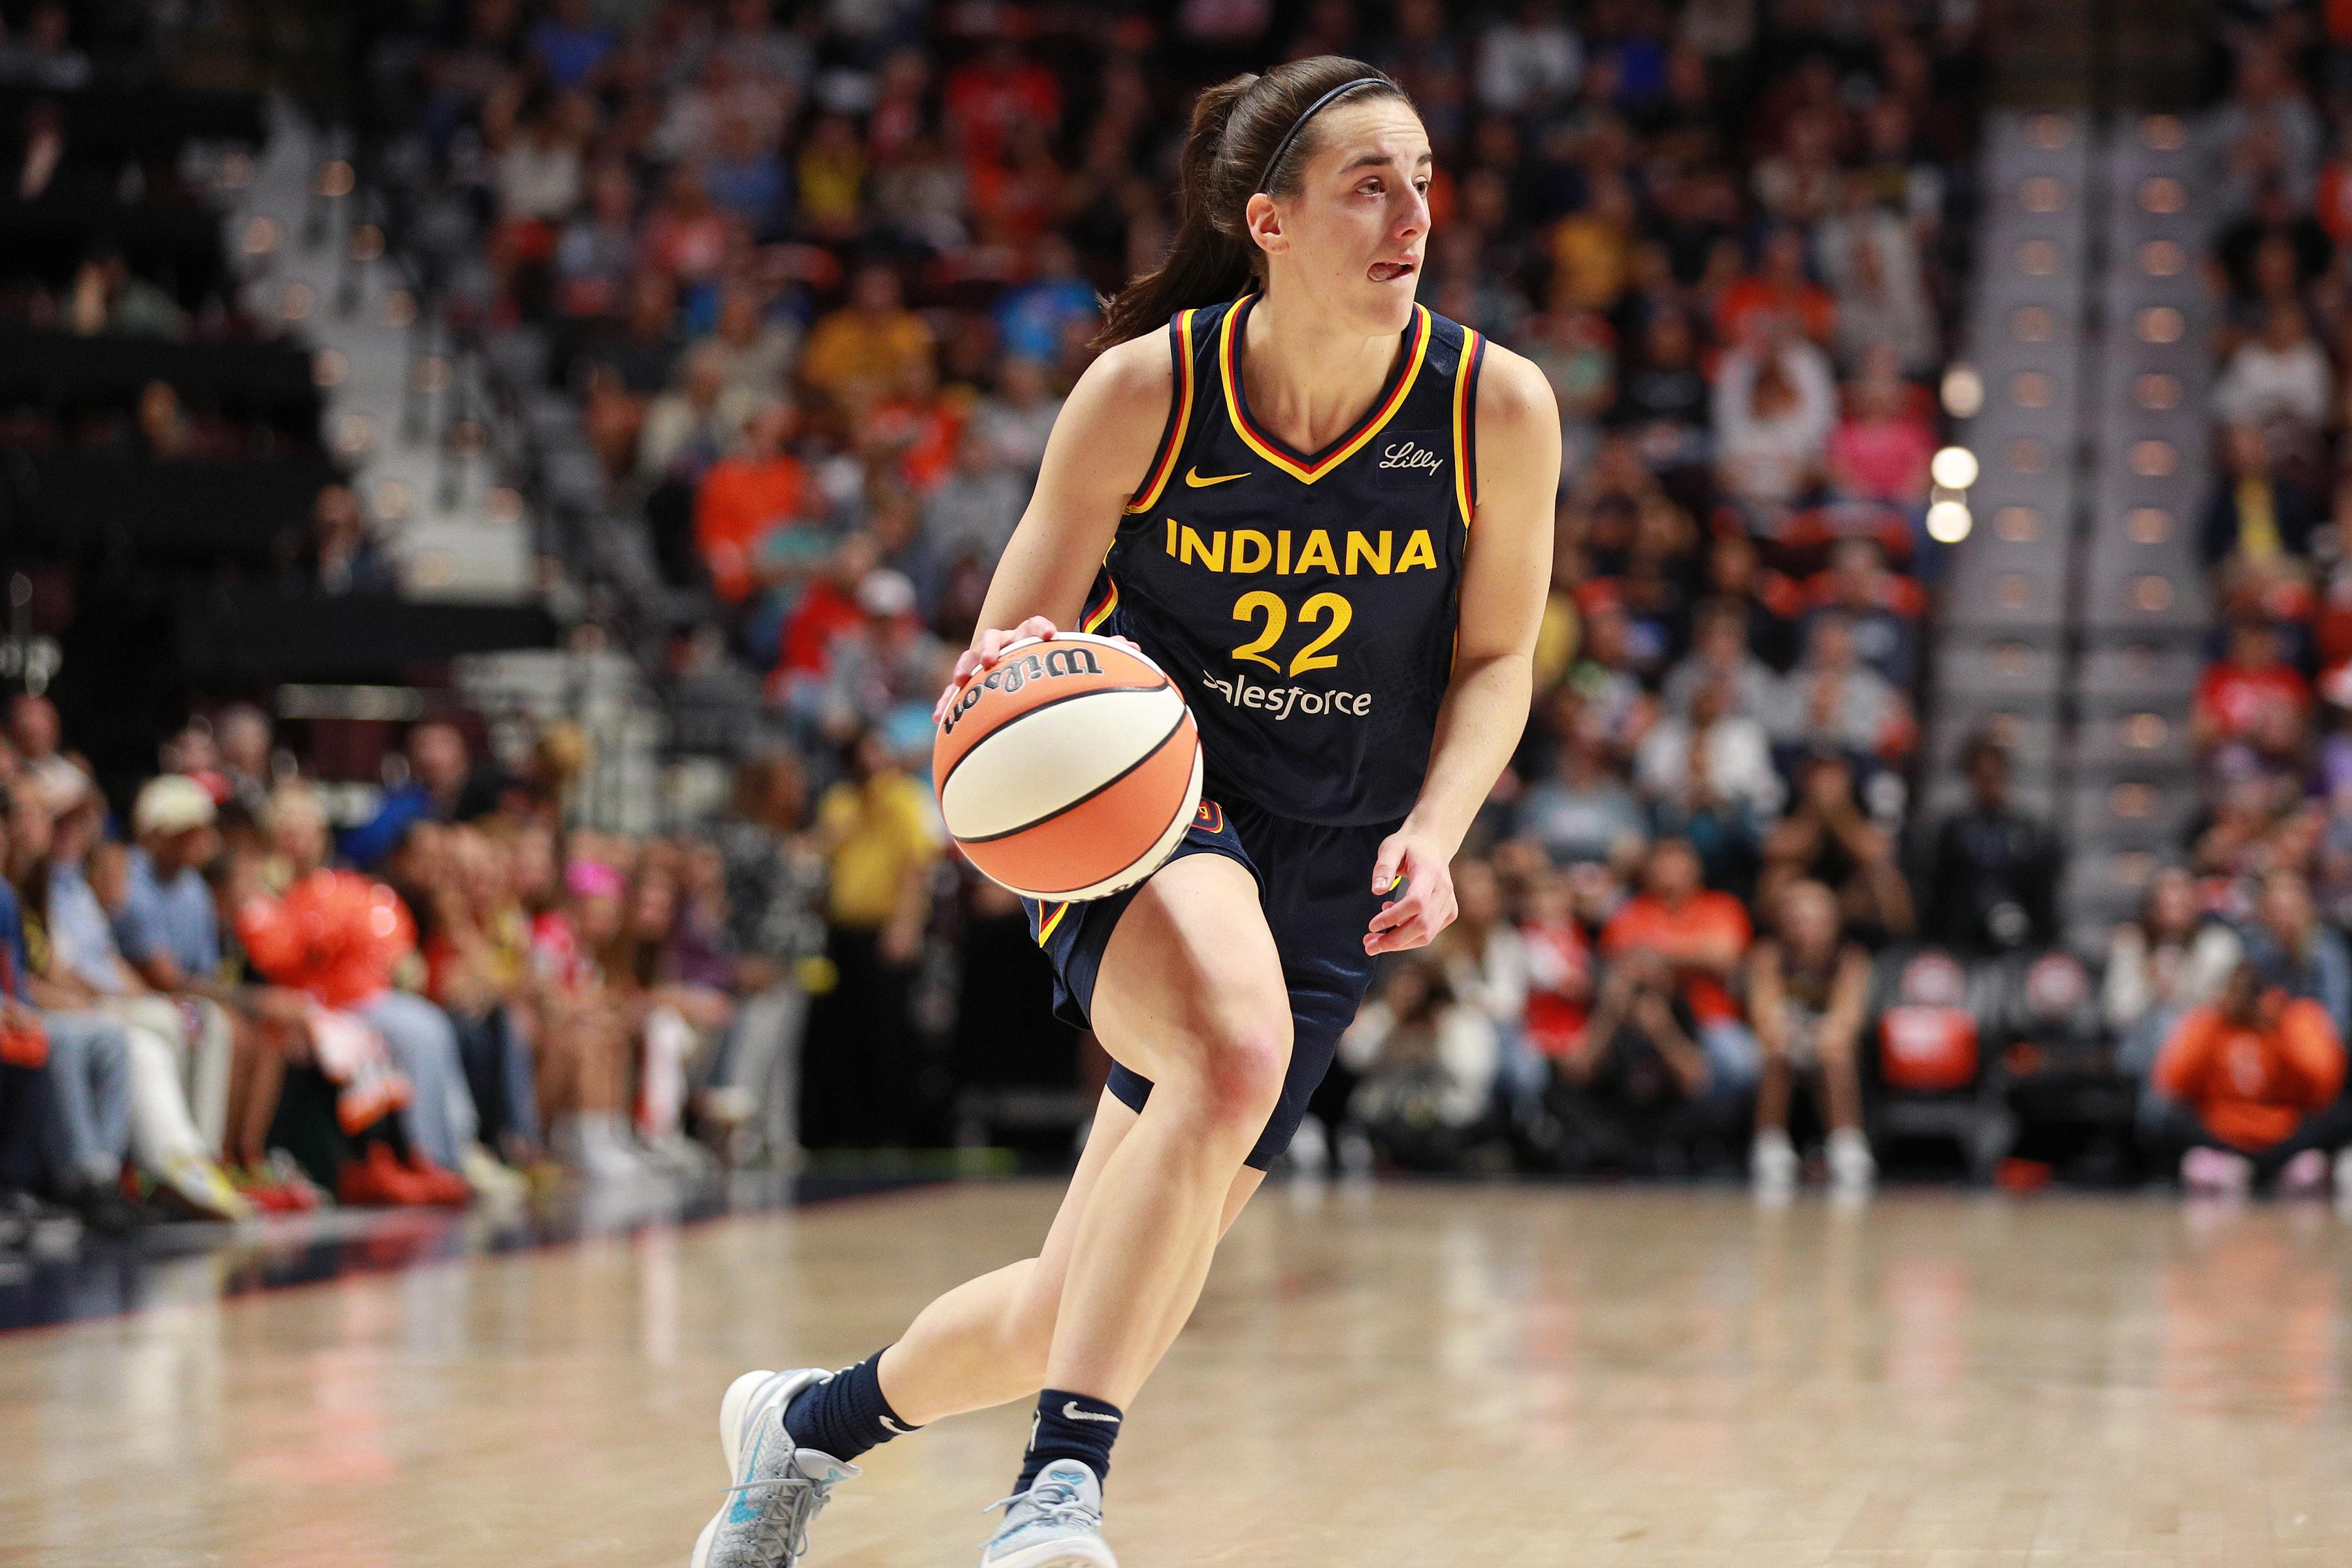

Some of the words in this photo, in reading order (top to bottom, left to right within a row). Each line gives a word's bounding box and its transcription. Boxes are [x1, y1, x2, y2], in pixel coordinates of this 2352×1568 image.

[1379, 442, 1443, 476] Lilly
[1166, 518, 1437, 576] INDIANA
[1232, 591, 1353, 678] 22
[944, 647, 1105, 735] Wilson
[1203, 670, 1371, 720] salesforce
